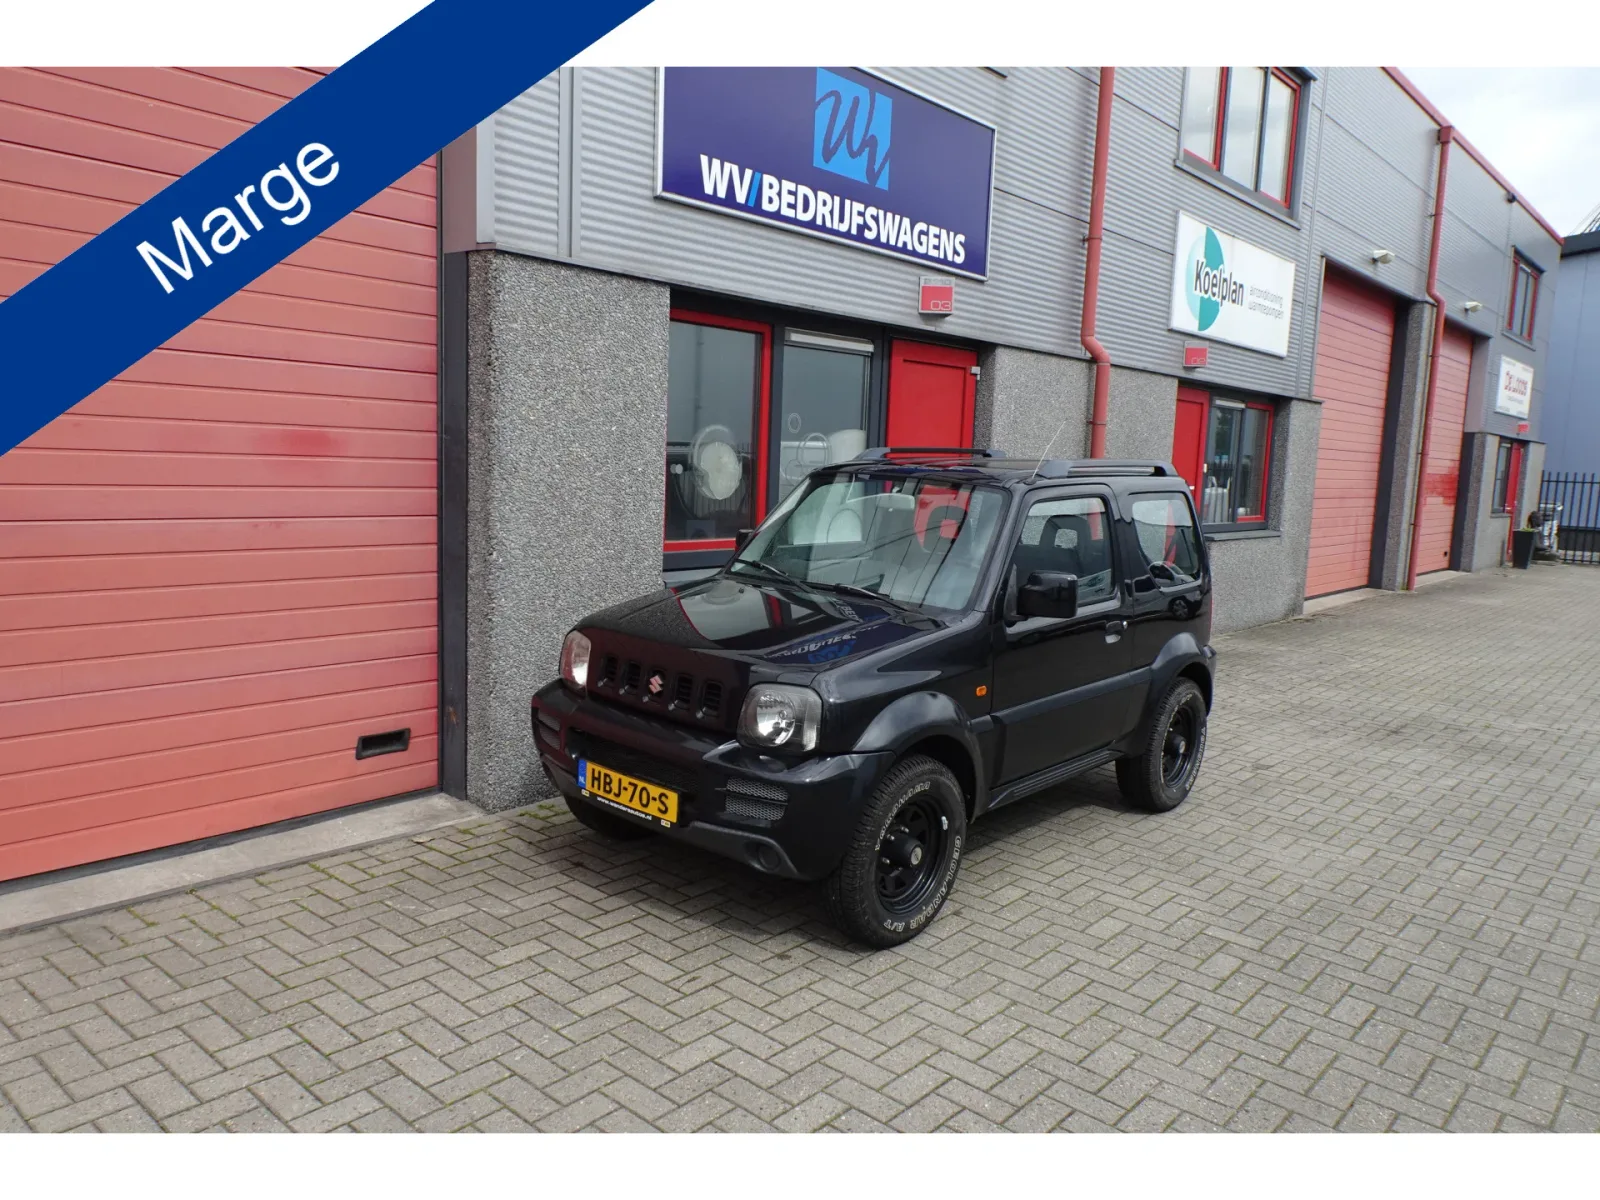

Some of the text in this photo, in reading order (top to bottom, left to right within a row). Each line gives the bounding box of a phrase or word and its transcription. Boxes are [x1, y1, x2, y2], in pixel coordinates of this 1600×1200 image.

[930, 300, 952, 311] 03
[1194, 259, 1245, 307] Koelplan
[591, 768, 669, 815] HBJ-70-S
[883, 835, 962, 932] GEOLANDAR A/T
